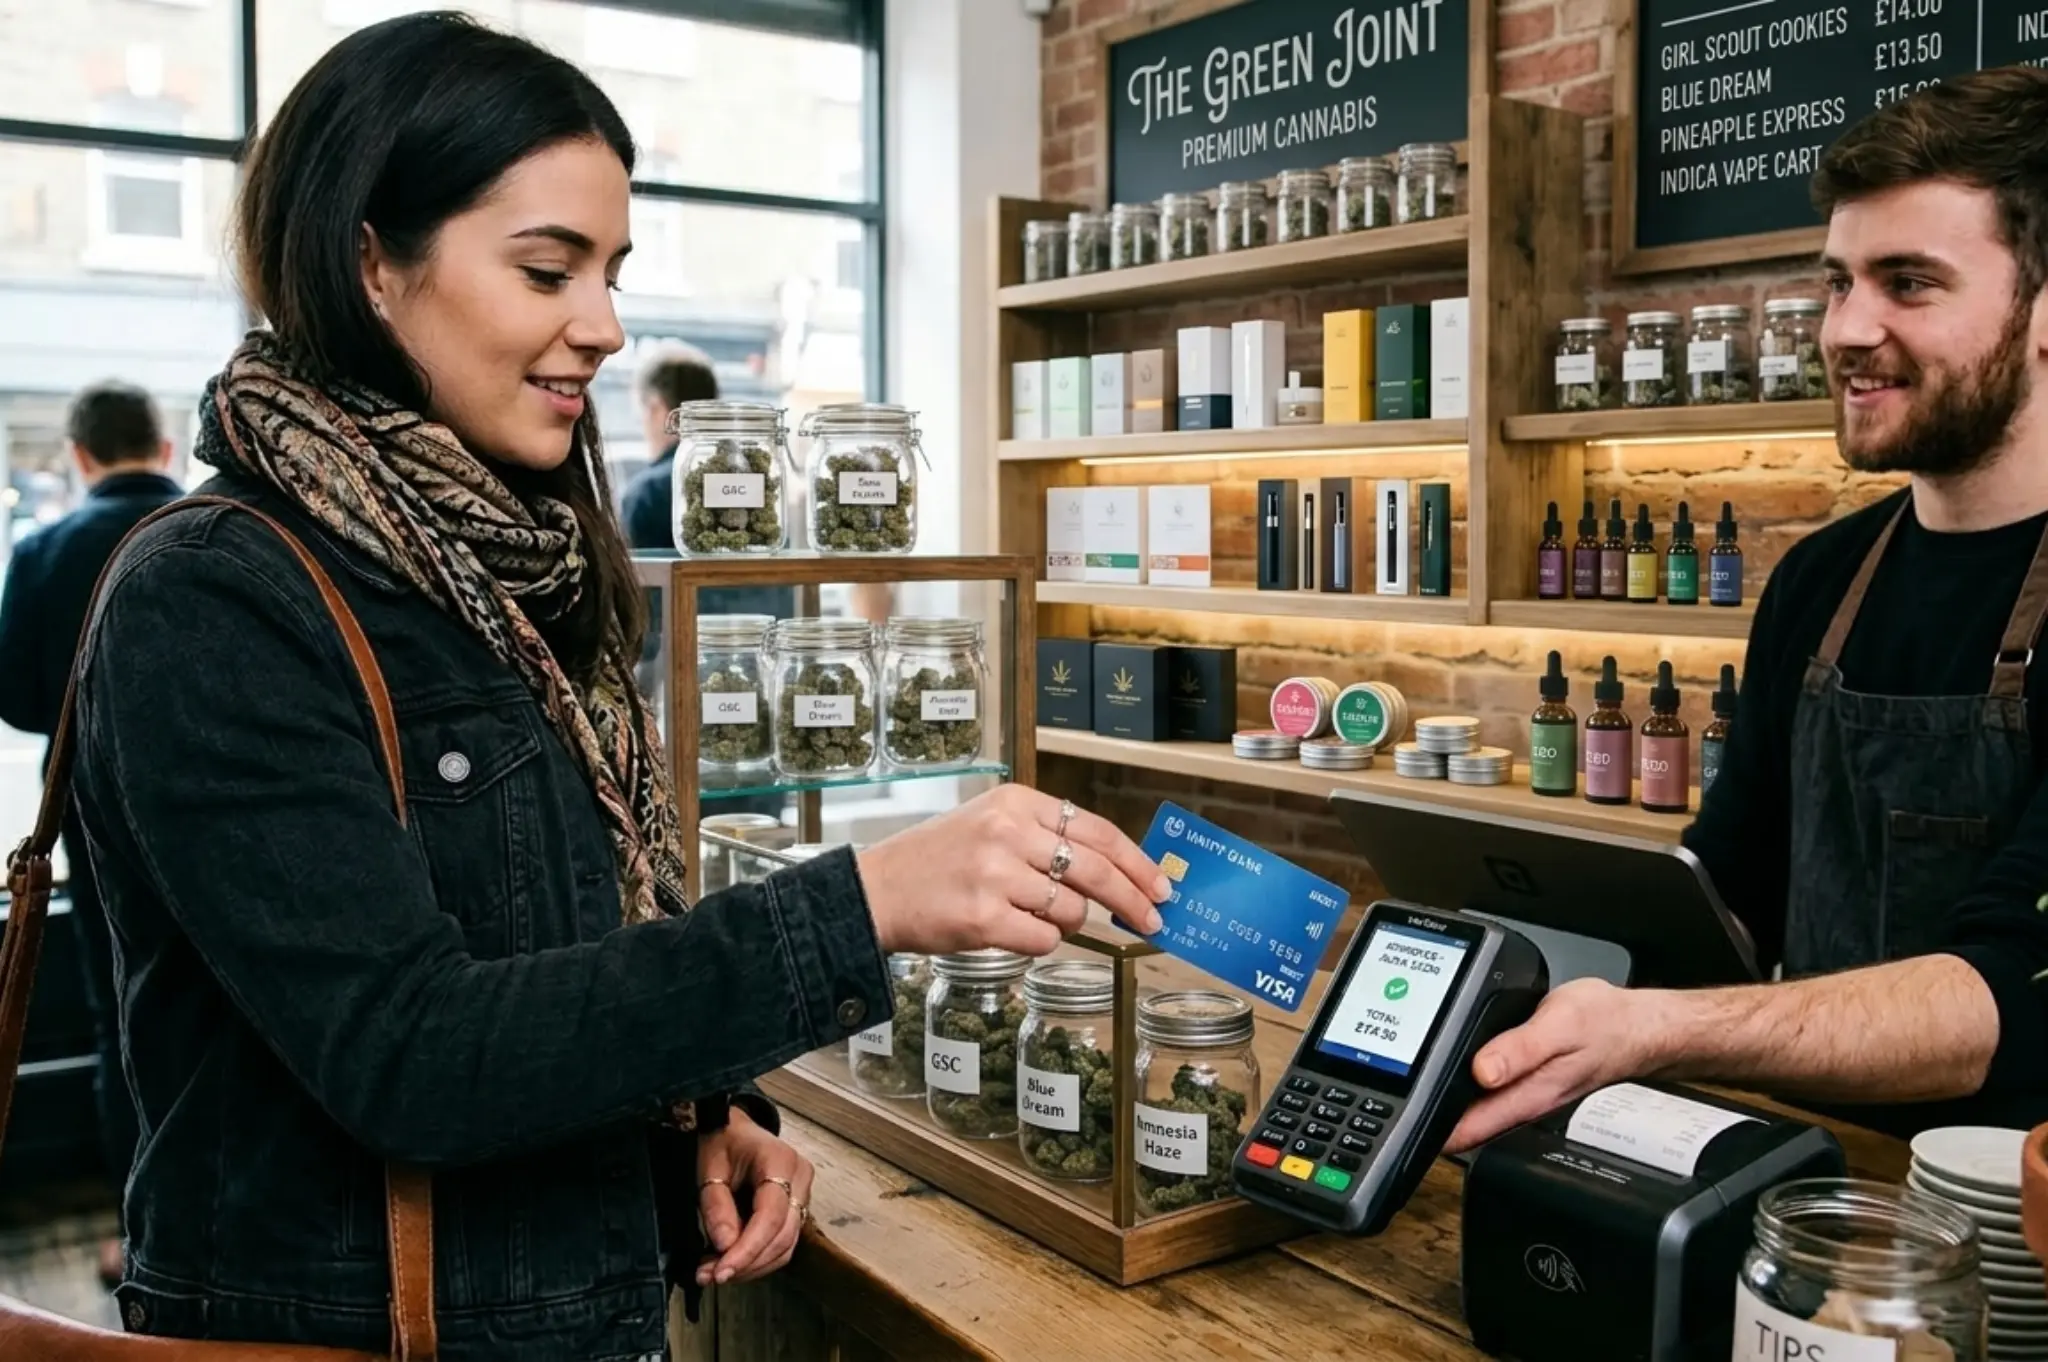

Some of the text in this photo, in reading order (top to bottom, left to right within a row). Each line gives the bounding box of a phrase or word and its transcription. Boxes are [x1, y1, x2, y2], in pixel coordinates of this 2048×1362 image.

[1661, 40, 1700, 71] GIRL
[1705, 26, 1763, 61] SCOUT
[1768, 7, 1848, 49] COOKIES
[1127, 0, 1444, 135] THE GREEN JOINT
[1661, 31, 1942, 113] BLUE DREAM £13.50
[1182, 96, 1378, 169] PREMIUM CANNABIS
[1661, 112, 1756, 154] PINEAPPLE
[1762, 97, 1846, 137] EXPRESS
[1660, 144, 1823, 196] INDICA VAPE CART
[1255, 969, 1296, 1004] VISA
[931, 1052, 962, 1074] GSC
[1027, 1077, 1056, 1097] Blue
[1145, 1138, 1182, 1160] Haze
